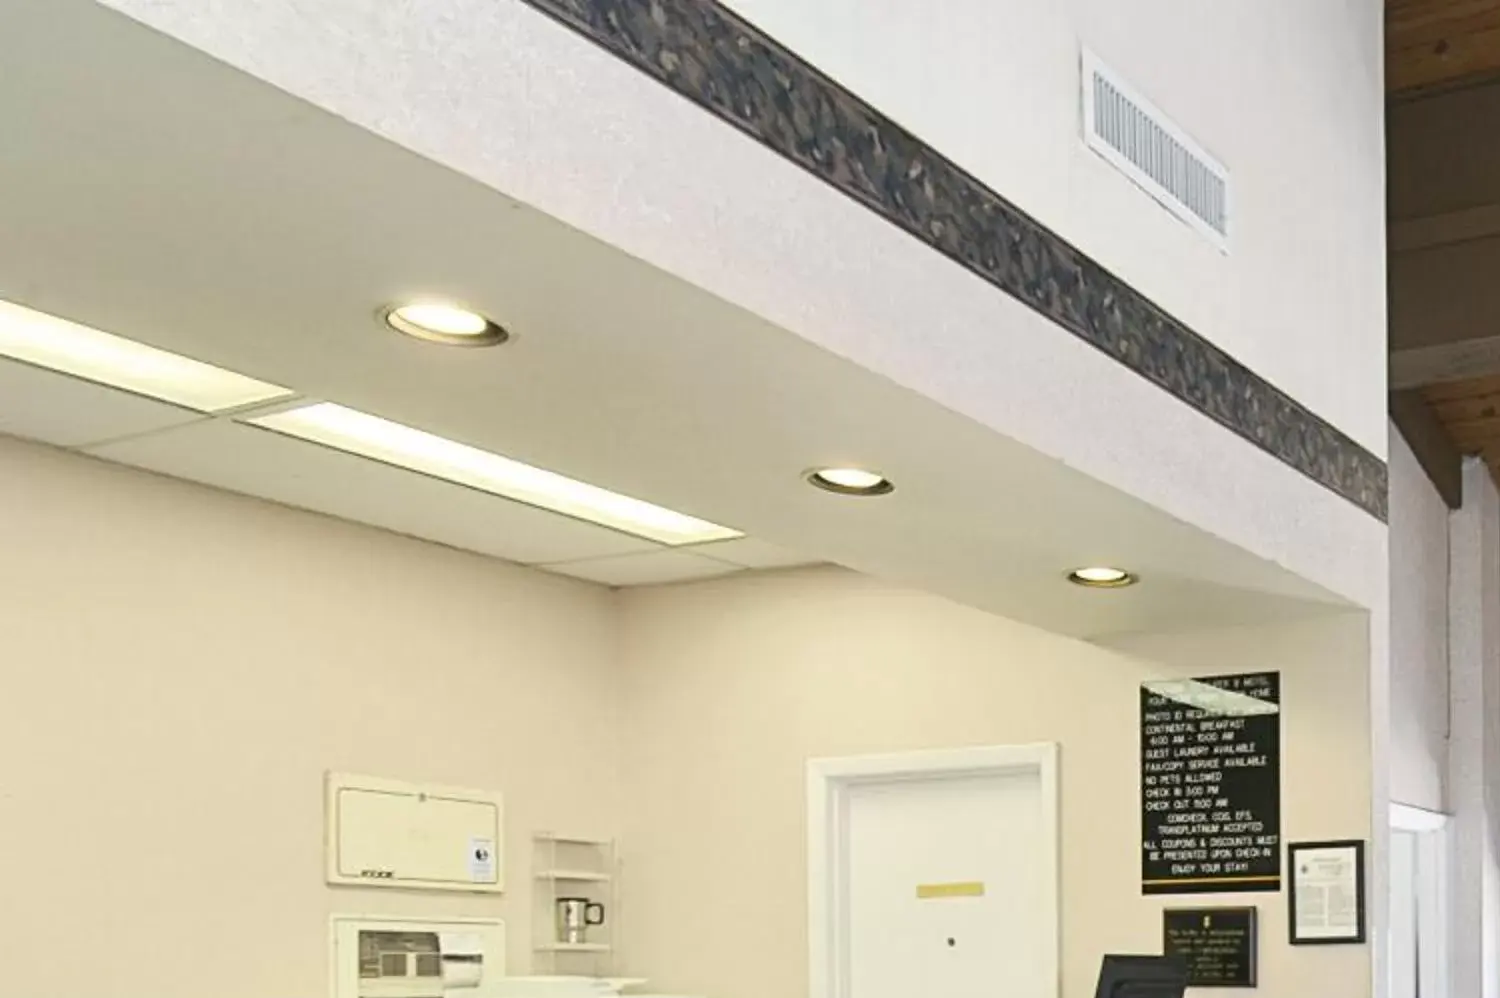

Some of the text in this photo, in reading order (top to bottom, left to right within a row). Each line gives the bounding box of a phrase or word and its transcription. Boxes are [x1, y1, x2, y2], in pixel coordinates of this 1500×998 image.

[1145, 719, 1245, 735] CONTINENTAL BREAKFAST
[1145, 742, 1256, 760] GUEST LAUNDRY AVAILABLE
[1188, 758, 1220, 771] SERVICE
[1224, 755, 1267, 768] AVAILABLE
[1145, 771, 1223, 785] NO PETS ALLOWED
[1145, 786, 1170, 799] CHECK
[1145, 800, 1171, 812] CHECK
[1173, 799, 1190, 810] OUT
[1223, 820, 1264, 833] ACCEPTED
[1161, 837, 1198, 850] COUPONS
[1209, 835, 1254, 848] DISCOUNTS
[1256, 834, 1278, 845] MUST
[1149, 851, 1160, 860] BE
[1163, 849, 1208, 861] PRESENTED
[1210, 848, 1233, 859] UPON
[1171, 863, 1196, 875] ENJOY
[1200, 862, 1222, 873] YOUR
